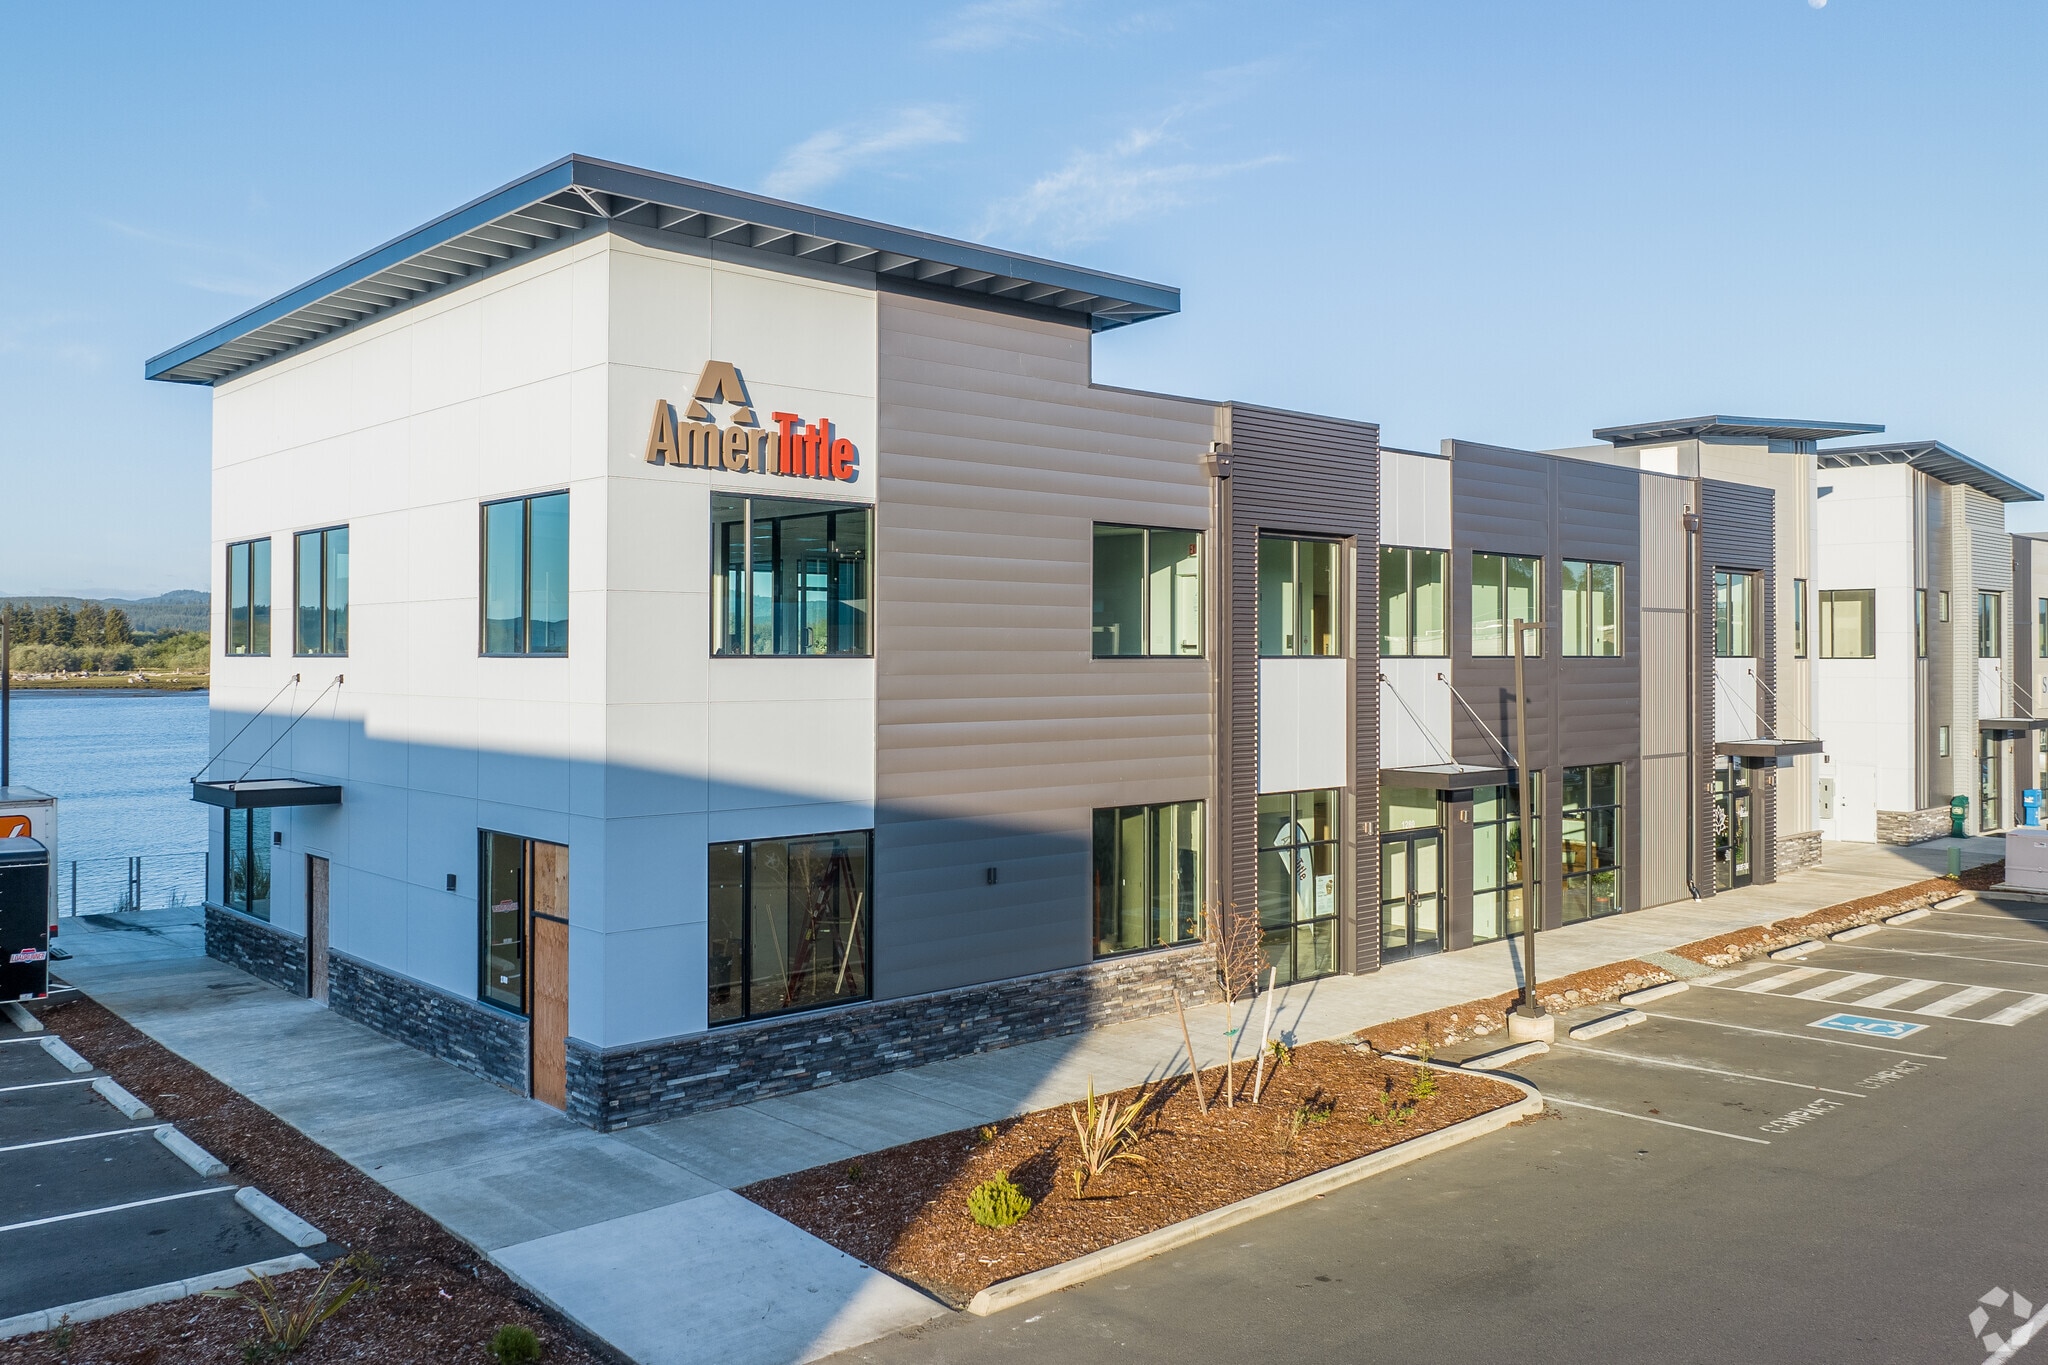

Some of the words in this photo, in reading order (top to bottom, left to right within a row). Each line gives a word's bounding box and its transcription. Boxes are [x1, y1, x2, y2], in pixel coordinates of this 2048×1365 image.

[643, 399, 855, 480] AmeriTitle
[1856, 1060, 1928, 1090] COMPACT
[1759, 1098, 1844, 1134] COMPACT
